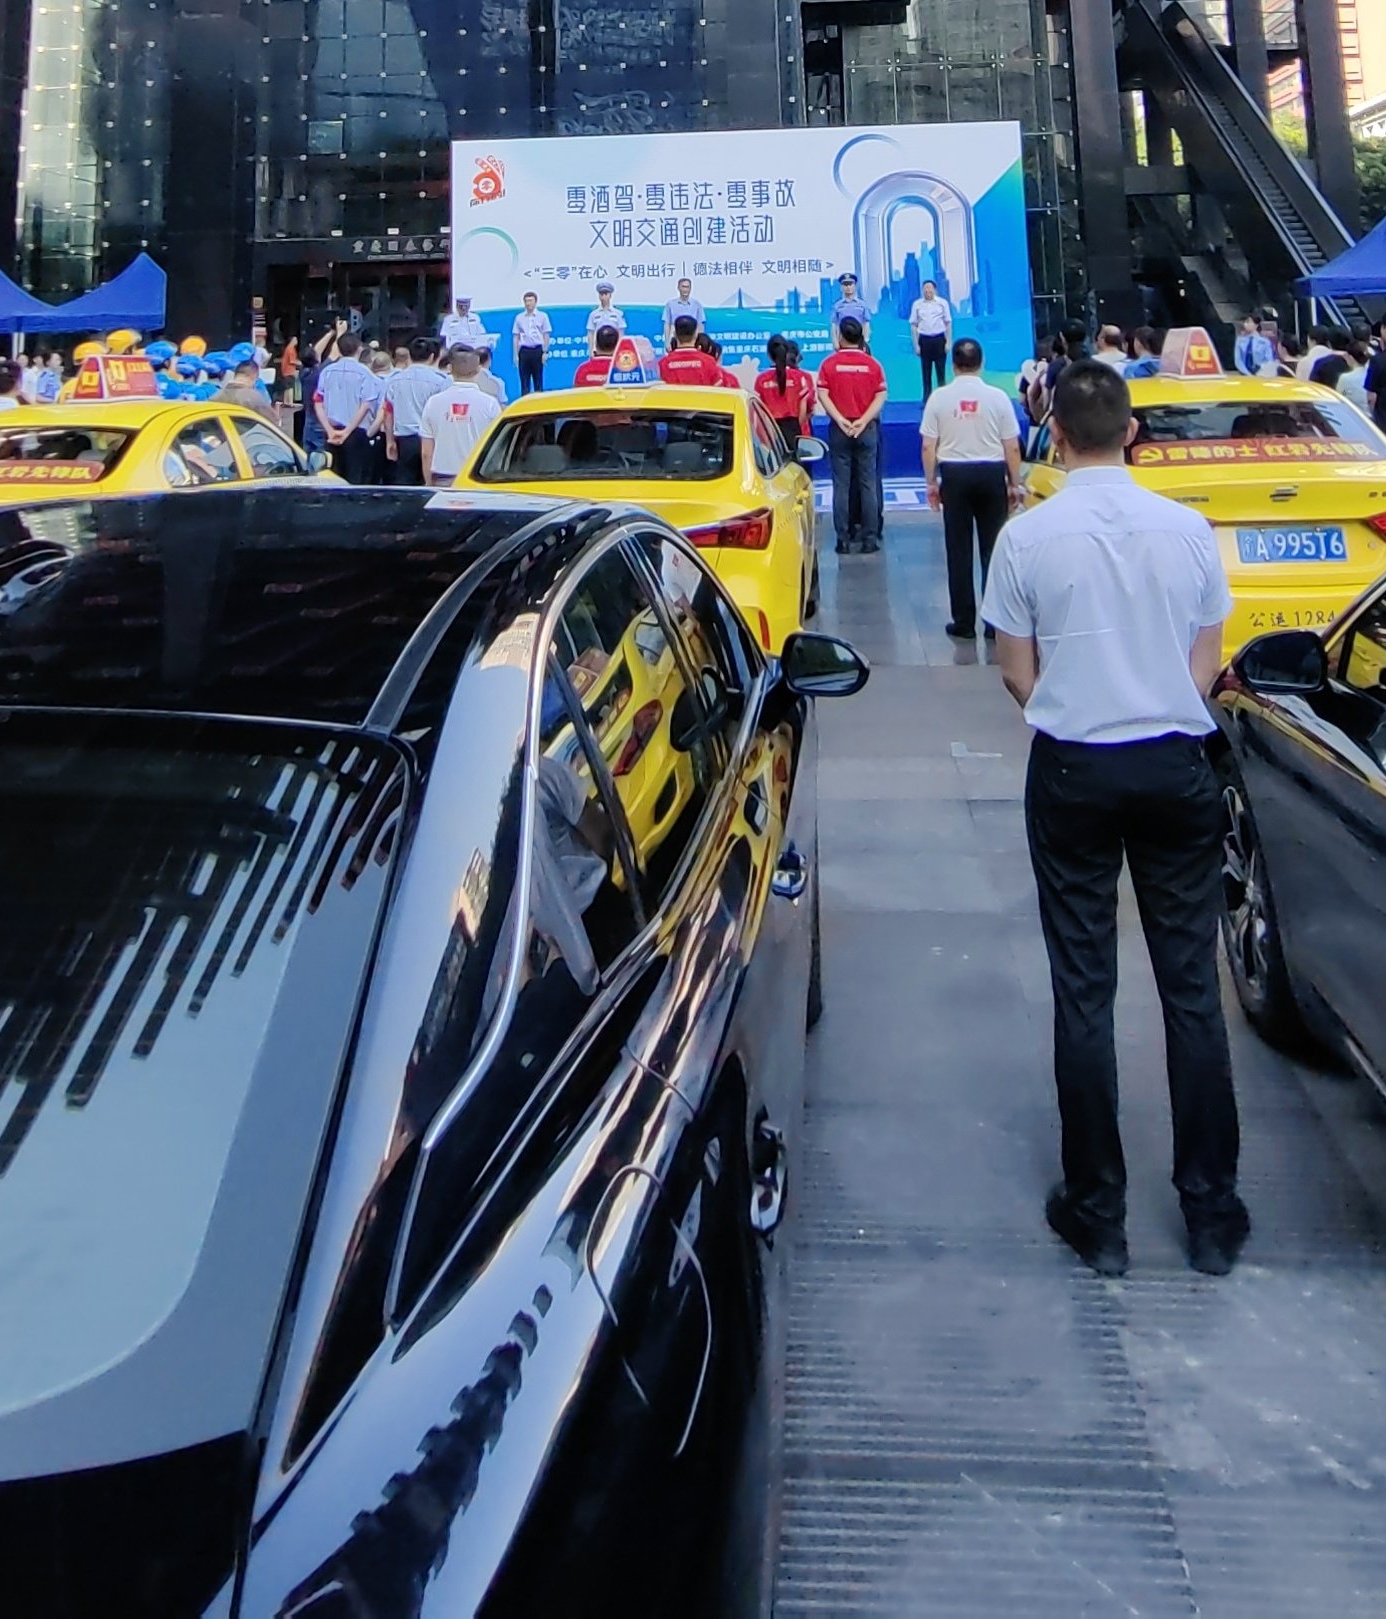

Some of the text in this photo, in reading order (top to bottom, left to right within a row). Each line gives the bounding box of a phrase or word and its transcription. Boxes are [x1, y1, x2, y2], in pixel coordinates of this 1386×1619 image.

[589, 215, 774, 249] 文明交通创建活动
[616, 262, 675, 279] 文明出行
[693, 260, 753, 277] 德法相伴
